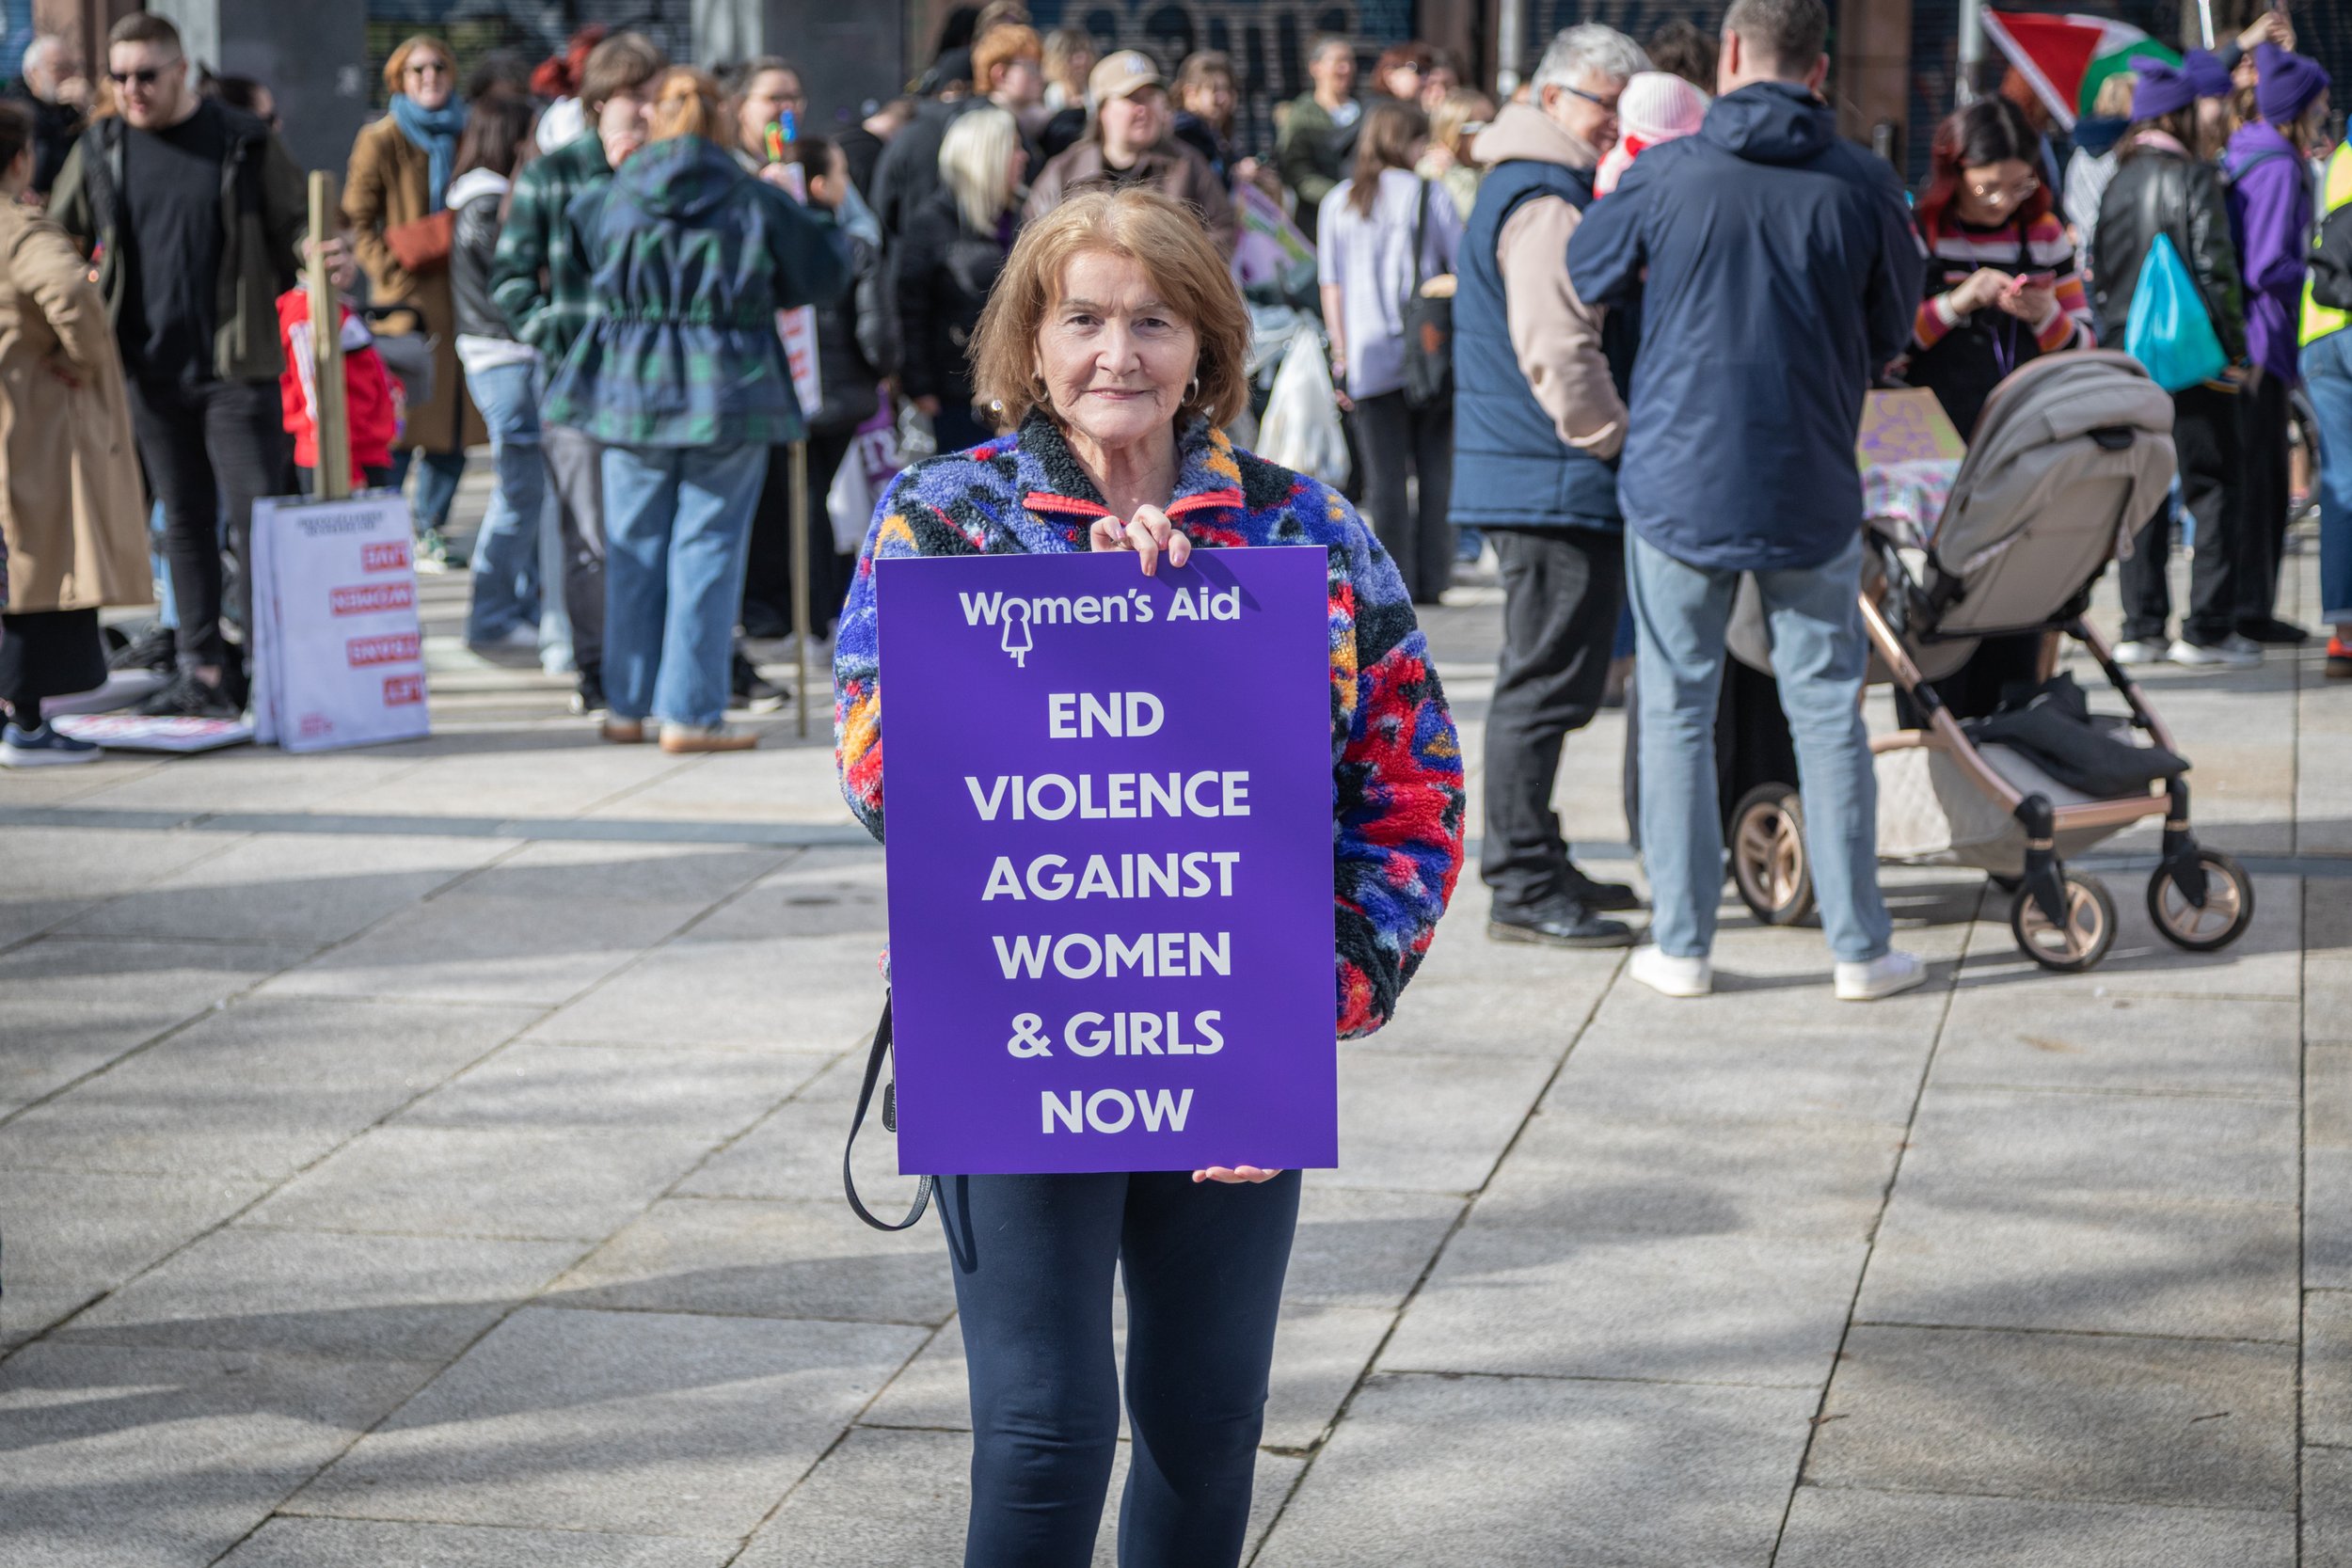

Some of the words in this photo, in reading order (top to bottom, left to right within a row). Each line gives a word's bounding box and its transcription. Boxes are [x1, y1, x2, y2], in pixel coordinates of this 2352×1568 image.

[333, 589, 408, 612] WOMEN
[959, 589, 1154, 632] Women's
[1167, 585, 1241, 622] Aid
[1048, 691, 1165, 739] END
[964, 769, 1251, 821] VIOLENCE
[981, 851, 1241, 902] AGAINST
[992, 931, 1232, 980] WOMEN
[1007, 1012, 1054, 1059] &
[1064, 1009, 1225, 1057] GIRLS
[1041, 1087, 1195, 1134] NOW
